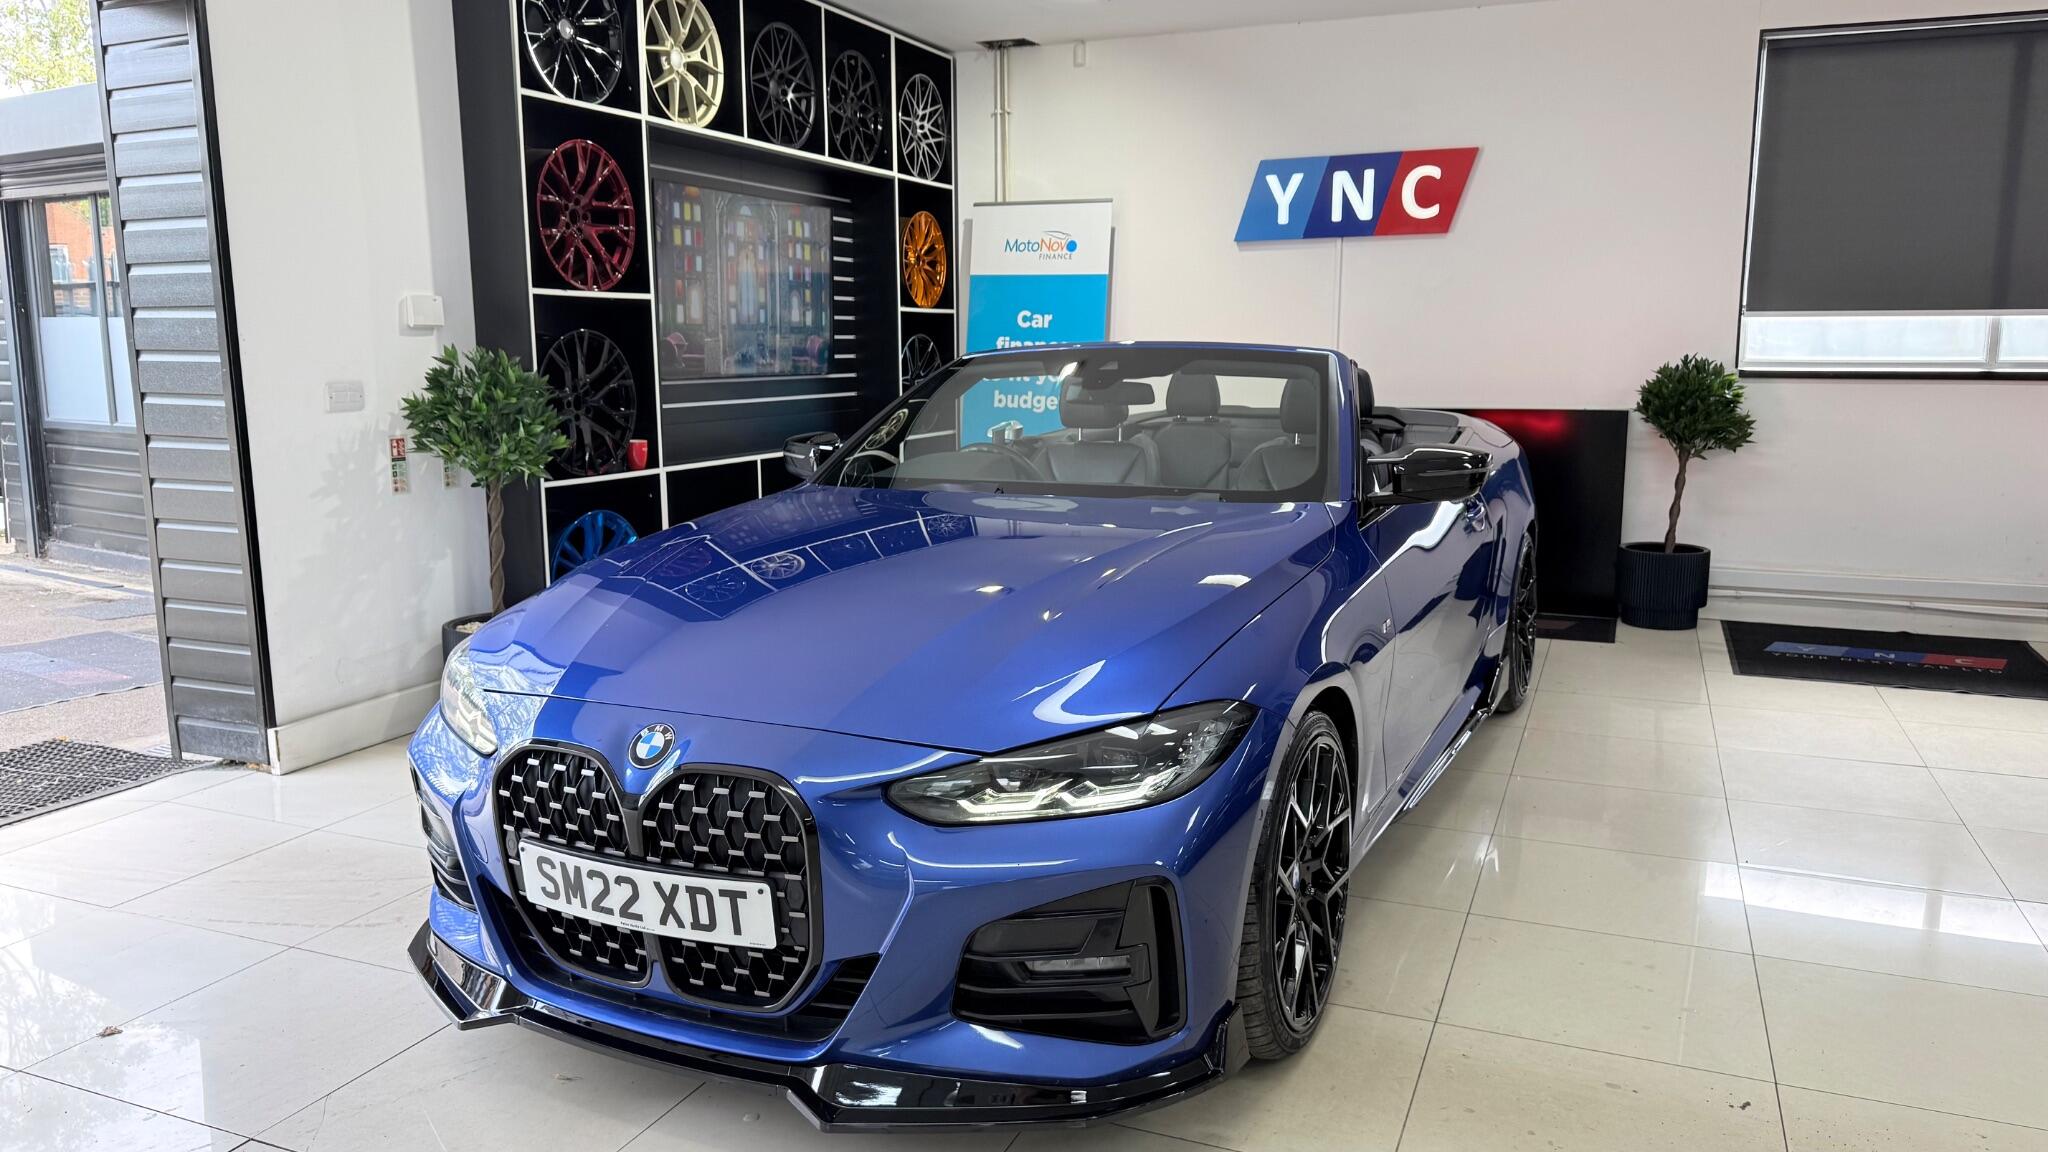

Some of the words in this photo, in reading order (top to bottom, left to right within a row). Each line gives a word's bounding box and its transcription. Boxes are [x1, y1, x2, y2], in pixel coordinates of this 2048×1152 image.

[1265, 165, 1442, 225] YNC
[1004, 238, 1078, 253] MotoNovo
[1039, 252, 1073, 260] FINANCE
[1017, 310, 1053, 328] Car
[993, 390, 1058, 412] budge
[640, 725, 673, 740] BMW
[536, 855, 643, 922] SM22
[653, 880, 748, 936] XDT
